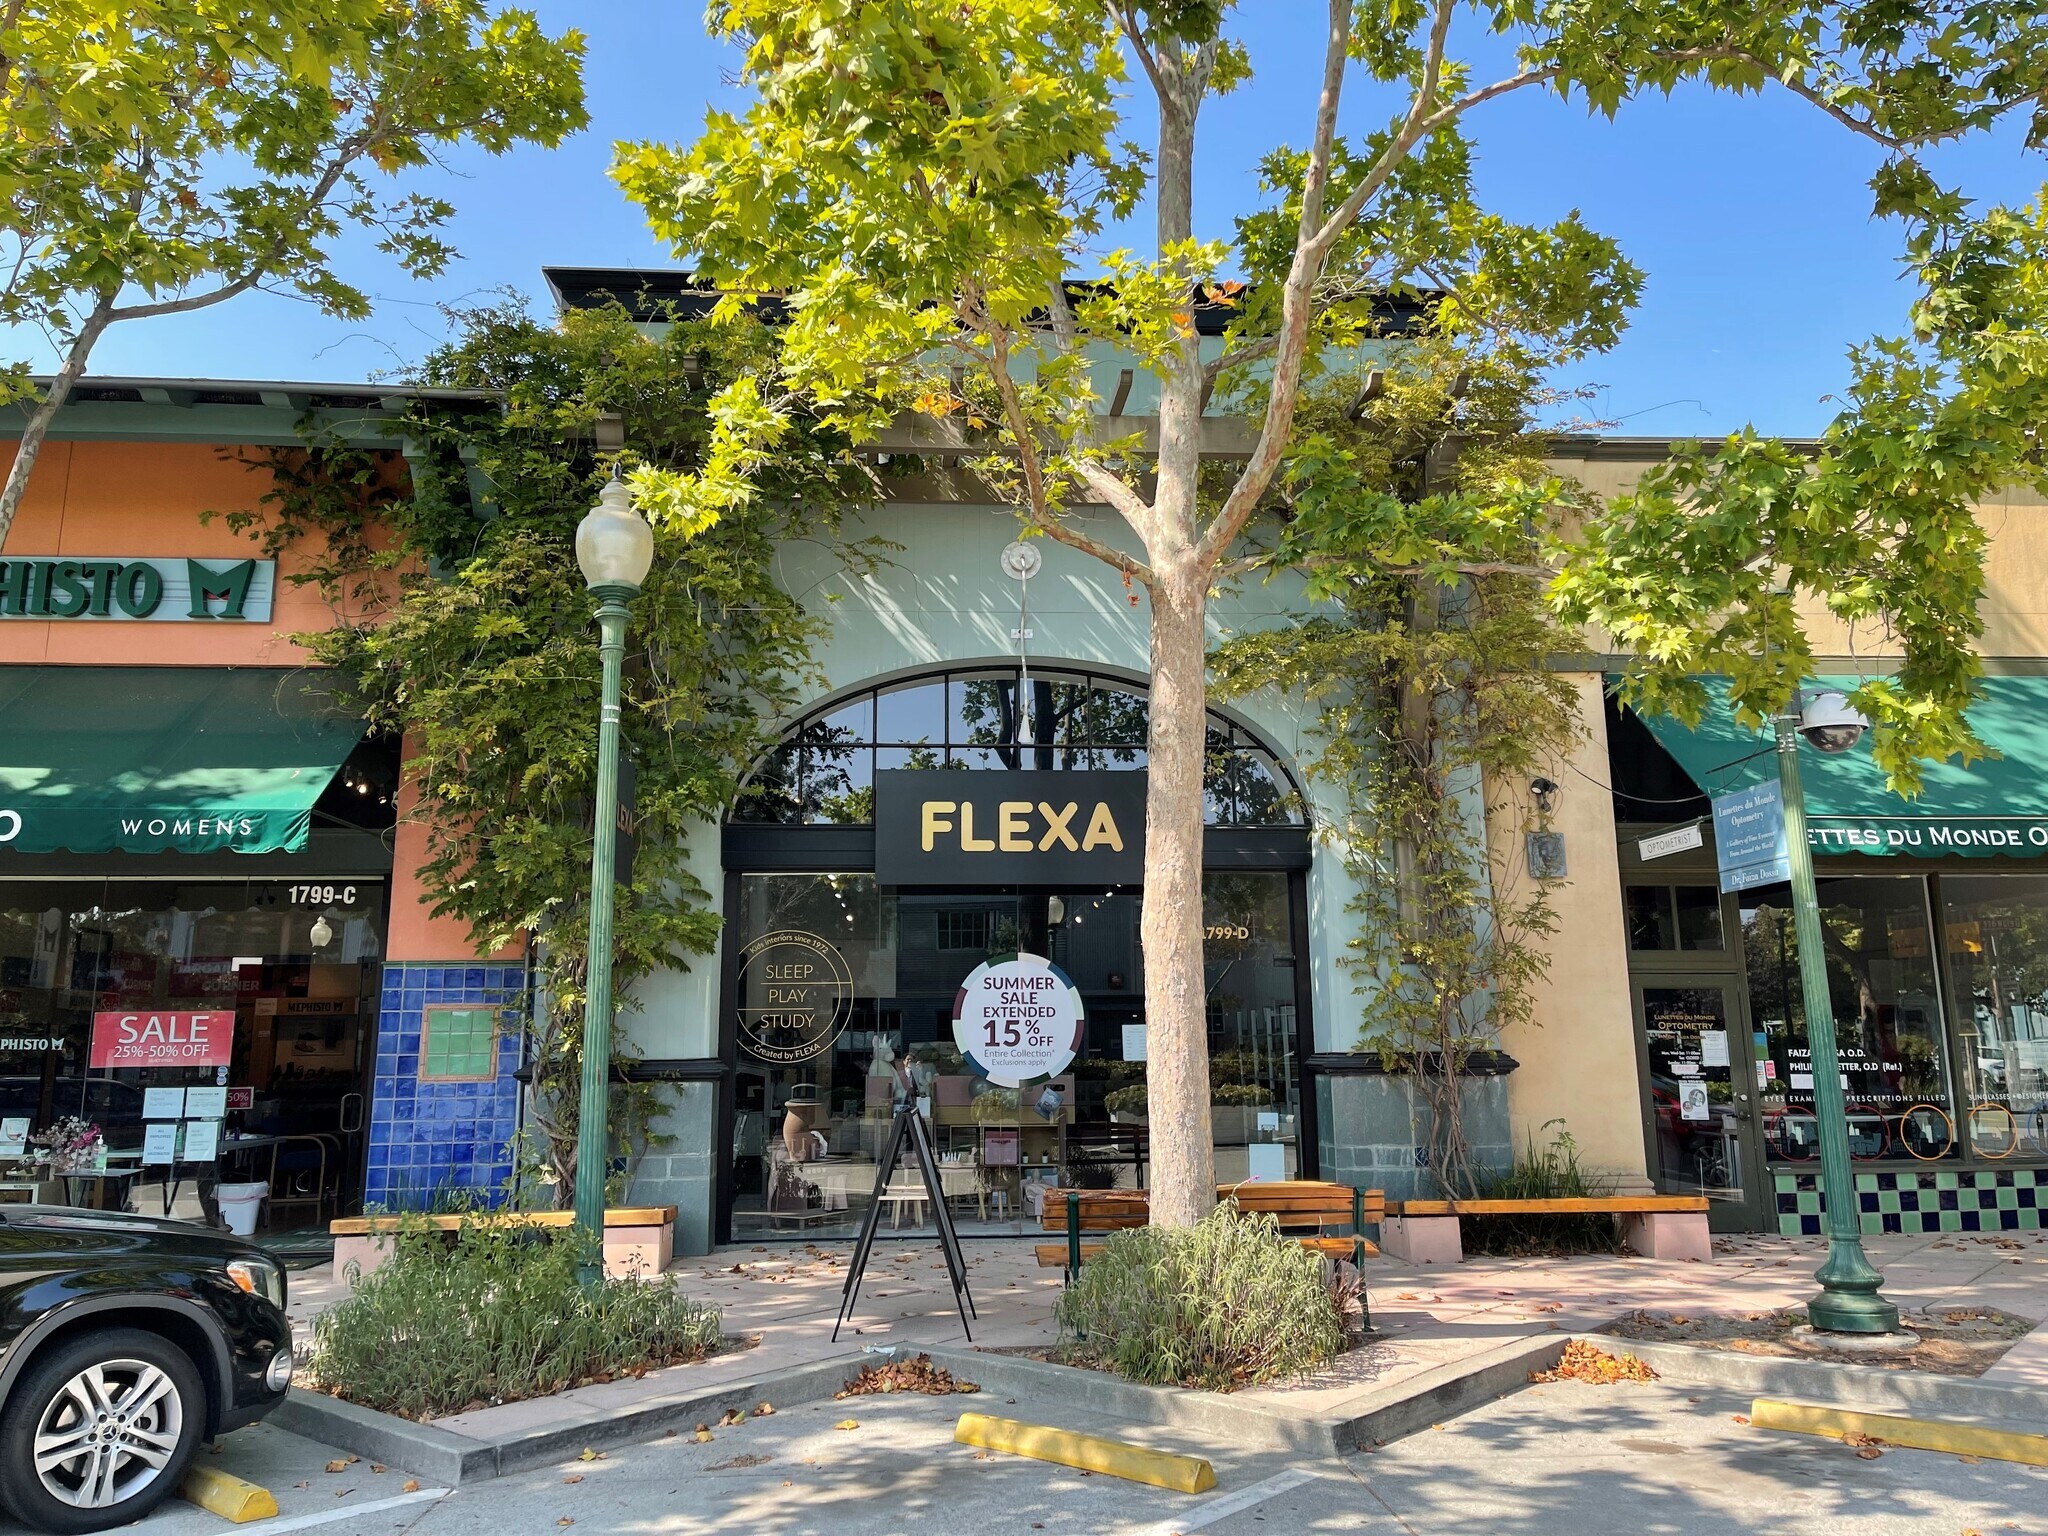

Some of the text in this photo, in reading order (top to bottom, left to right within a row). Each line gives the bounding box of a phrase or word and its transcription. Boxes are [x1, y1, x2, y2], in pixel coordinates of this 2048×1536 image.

[1718, 792, 1776, 817] Lunettes du Monde
[1731, 811, 1764, 827] Optometry
[121, 818, 252, 836] WOMENS
[921, 801, 1124, 853] FLEXA
[1647, 833, 1691, 854] OPTOMETRIST
[1807, 829, 1880, 846] ETTES
[1888, 829, 1921, 846] DU
[1742, 871, 1759, 882] Faiza
[1760, 868, 1779, 878] Dossa
[288, 885, 356, 904] 1799-C
[749, 933, 829, 955] Kids interiors since 1972
[765, 964, 814, 979] SLEEP
[983, 977, 1055, 990] SUMMER
[769, 988, 808, 1003] PLAY
[1000, 991, 1038, 1005] SALE
[287, 1002, 331, 1013] MEPHISTO
[983, 1006, 1056, 1018] EXTENDED
[760, 1013, 816, 1028] STUDY
[1658, 1021, 1713, 1030] OPTOMETRY
[118, 1015, 210, 1044] SALE
[1028, 1036, 1054, 1047] OFF
[113, 1044, 210, 1058] 25%-50% OFF
[753, 1043, 821, 1060] Created by FLEXA
[984, 1049, 1009, 1058] Entire
[1847, 1048, 1866, 1058] O.D.
[991, 1058, 1047, 1068] Exclusions apply
[1838, 1062, 1862, 1073] ETTER,
[1883, 1062, 1903, 1073] (Ret.)
[227, 1092, 249, 1102] 50%
[1764, 1095, 1785, 1103] EYES
[1846, 1094, 1914, 1102] PRESCRIPTIONS
[1917, 1094, 1946, 1102] FILLED
[1968, 1093, 2011, 1101] SUNGLASSES
